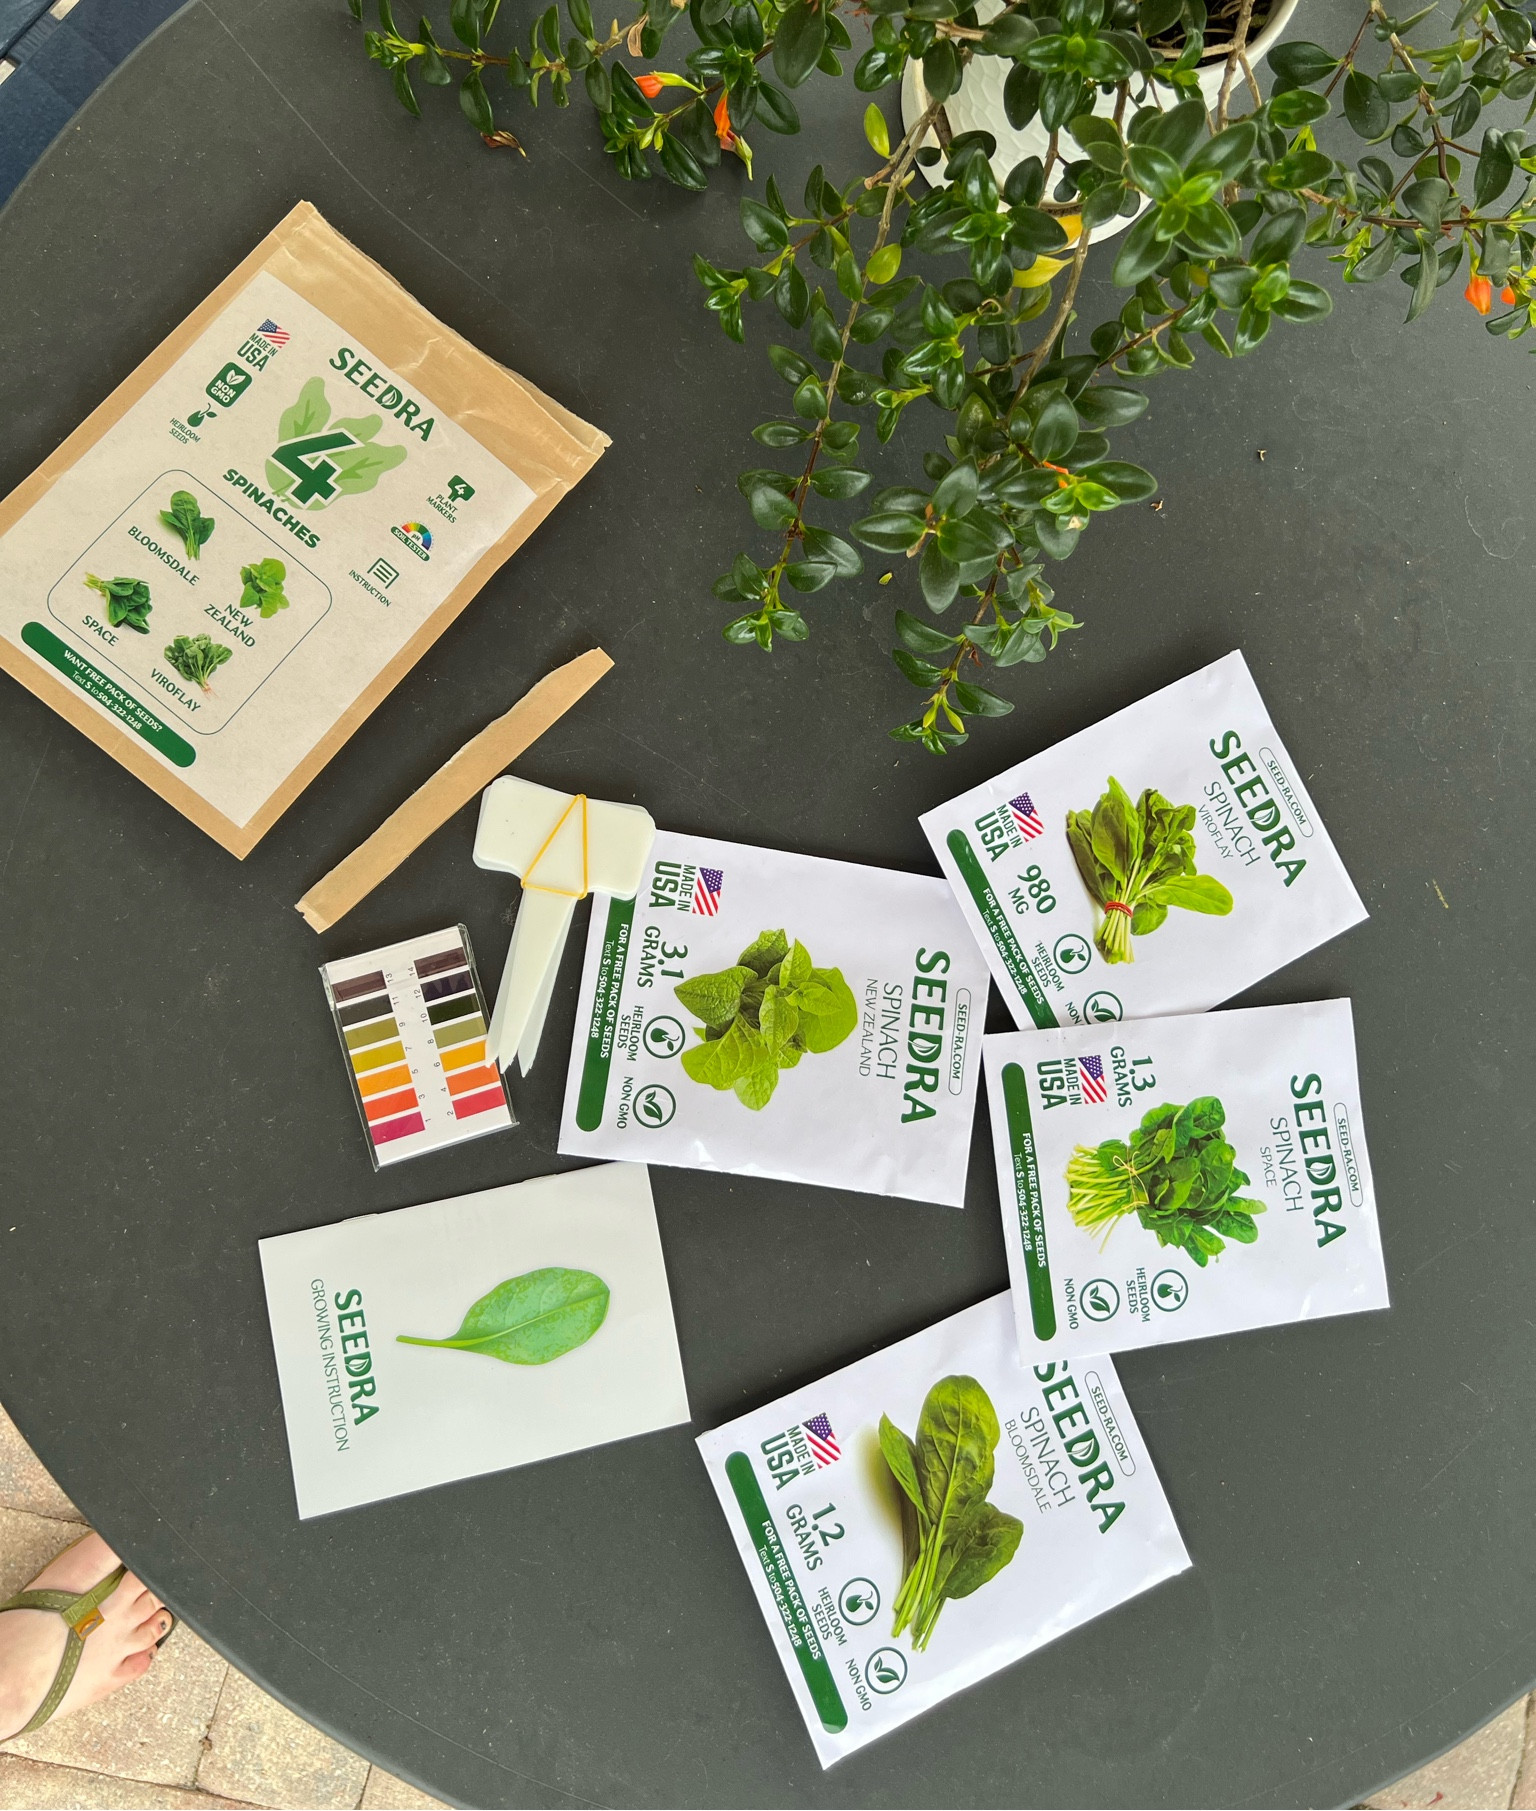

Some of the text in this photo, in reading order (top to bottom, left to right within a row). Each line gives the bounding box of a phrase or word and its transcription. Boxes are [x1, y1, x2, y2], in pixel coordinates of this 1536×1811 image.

[237, 340, 269, 372] USA
[249, 333, 278, 357] MADE IN
[211, 387, 230, 403] GMO
[215, 380, 236, 399] NON
[329, 348, 435, 442] SEEDRA
[169, 417, 201, 443] HEIRLOOM
[169, 428, 189, 444] SEEDS
[271, 432, 356, 504] 4
[454, 484, 467, 495] 4
[223, 469, 321, 548] SPINACHES
[426, 496, 457, 523] MARKERS
[435, 494, 458, 513] PLANT
[128, 526, 200, 586] BLOOMSDALE
[394, 528, 427, 560] SOIL TESTER
[348, 569, 392, 607] INSTRUCTION
[82, 615, 119, 647] SPACE
[204, 604, 255, 647] ZEALAND
[224, 604, 253, 627] NEW
[64, 650, 163, 732] WANT FREE PACK OF SEEDS?
[72, 671, 86, 685] Text
[151, 668, 201, 712] VIROFLAY
[1209, 730, 1307, 887] SEEDRA
[1267, 757, 1306, 827] SEED-RA.COM
[975, 811, 1010, 863] USA
[994, 804, 1023, 848] MADE IN
[1198, 804, 1234, 859] VIROFLAY
[1204, 781, 1261, 866] SPINACH
[649, 861, 682, 908] USA
[677, 864, 696, 912] MADE IN
[1008, 887, 1029, 914] MG
[1017, 865, 1056, 914] 980
[618, 923, 629, 944] FOR
[982, 909, 993, 925] Text
[604, 940, 614, 957] Text
[612, 954, 624, 980] FREE
[637, 926, 661, 988] GRAMS
[657, 941, 688, 979] 3.1
[983, 888, 996, 908] FOR
[996, 915, 1012, 939] FREE
[1007, 937, 1023, 962] PACK
[1019, 962, 1030, 974] OF
[1025, 975, 1044, 1004] SEEDS
[1035, 942, 1065, 992] HEIRLOOM
[385, 973, 393, 983] 13
[407, 966, 415, 976] 14
[413, 989, 421, 999] 12
[608, 981, 620, 1008] PACK
[1031, 957, 1051, 988] SEEDS
[392, 996, 399, 1005] 11
[420, 1013, 428, 1023] 10
[606, 1009, 615, 1024] OF
[1065, 1002, 1082, 1025] NON
[600, 1025, 613, 1058] SEEDS
[617, 1014, 631, 1049] SEEDS
[626, 1005, 644, 1061] HEIRLOOM
[859, 978, 878, 1077] NEW ZEALAND
[876, 982, 903, 1079] SPINACH
[901, 947, 950, 1123] SEEDRA
[949, 1003, 970, 1080] SEED-RA.COM
[1037, 1060, 1067, 1110] USA
[1063, 1058, 1082, 1105] MADE IN
[1110, 1046, 1132, 1107] GRAMS
[1129, 1056, 1156, 1091] 1.3
[616, 1076, 634, 1129] NON GMO
[1014, 1153, 1022, 1171] Text
[1260, 1146, 1277, 1187] SPACE
[1270, 1117, 1304, 1212] SPINACH
[1290, 1073, 1347, 1248] SEEDRA
[1337, 1116, 1359, 1194] SEED-RA.COM
[1022, 1133, 1046, 1268] FOR A FREE PACK OF SEEDS
[1064, 1278, 1079, 1330] NON GMO
[1126, 1280, 1139, 1314] SEEDS
[1136, 1267, 1150, 1322] HEIRLOOM
[311, 1279, 350, 1452] GROWING INSTRUCTION
[334, 1289, 379, 1426] SEEDRA
[1033, 1360, 1126, 1534] SEEDRA
[1088, 1386, 1128, 1461] SEED-RA.COM
[760, 1432, 800, 1491] USA
[787, 1425, 816, 1476] MADE IN
[1005, 1419, 1052, 1514] BLOOMSDALE
[1020, 1407, 1076, 1507] SPINACH
[786, 1504, 823, 1571] GRAMS
[804, 1503, 845, 1547] 1.2
[758, 1546, 770, 1564] Text
[762, 1520, 821, 1660] FOR A FREE PACK OF SEEDS
[811, 1603, 833, 1640] SEEDS
[818, 1586, 847, 1646] HEIRLOOM
[845, 1658, 872, 1711] NON GMO
